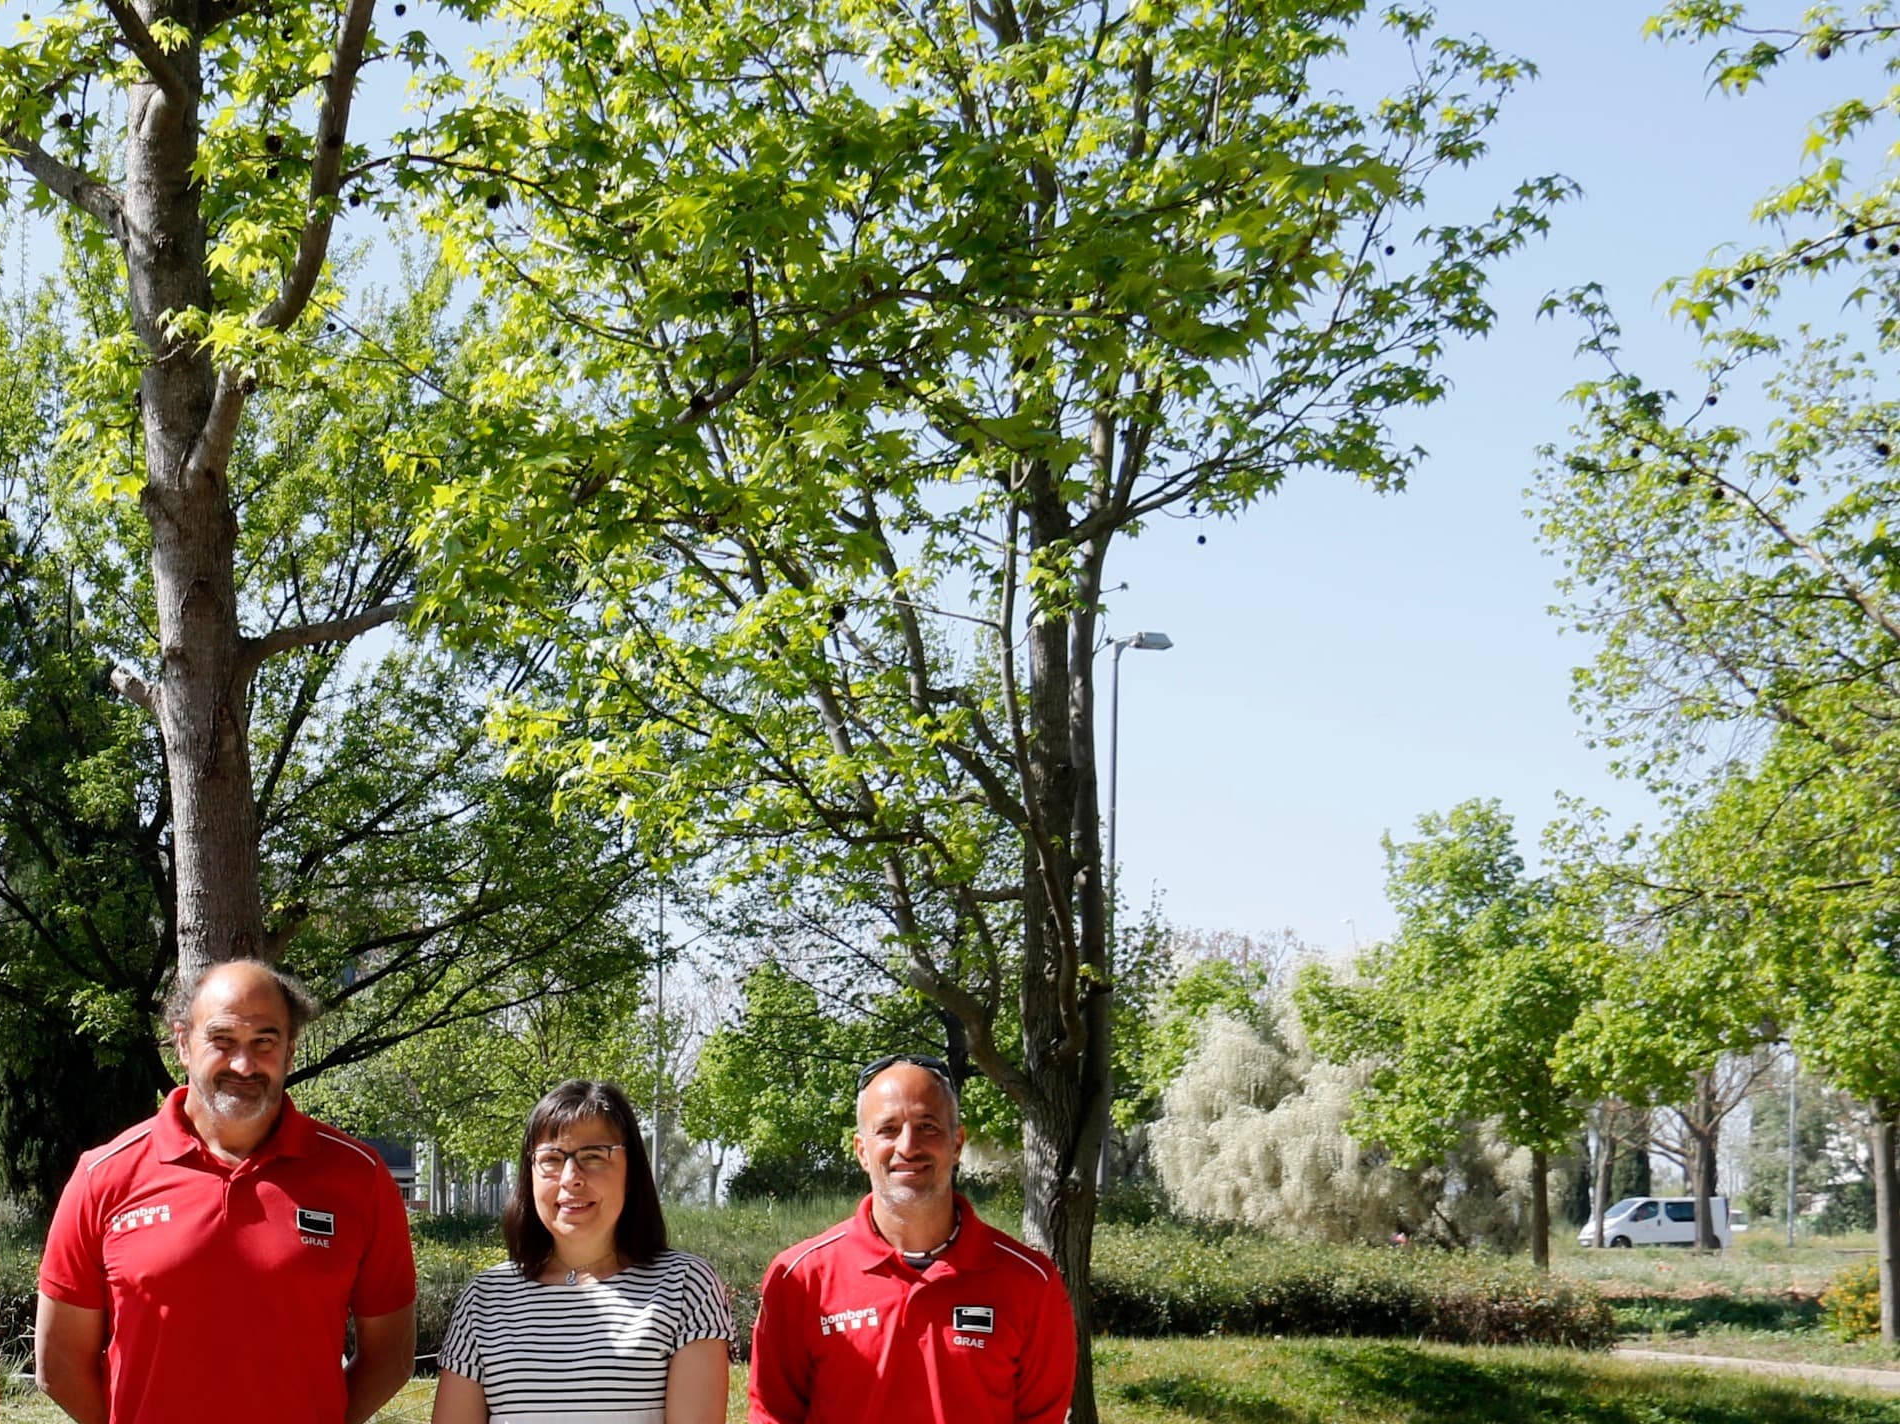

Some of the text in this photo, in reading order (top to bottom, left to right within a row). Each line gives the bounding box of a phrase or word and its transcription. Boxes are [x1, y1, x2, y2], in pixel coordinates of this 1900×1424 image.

[300, 1236, 330, 1249] GRAE
[820, 1307, 877, 1326] bombers
[953, 1335, 985, 1349] GRAE
